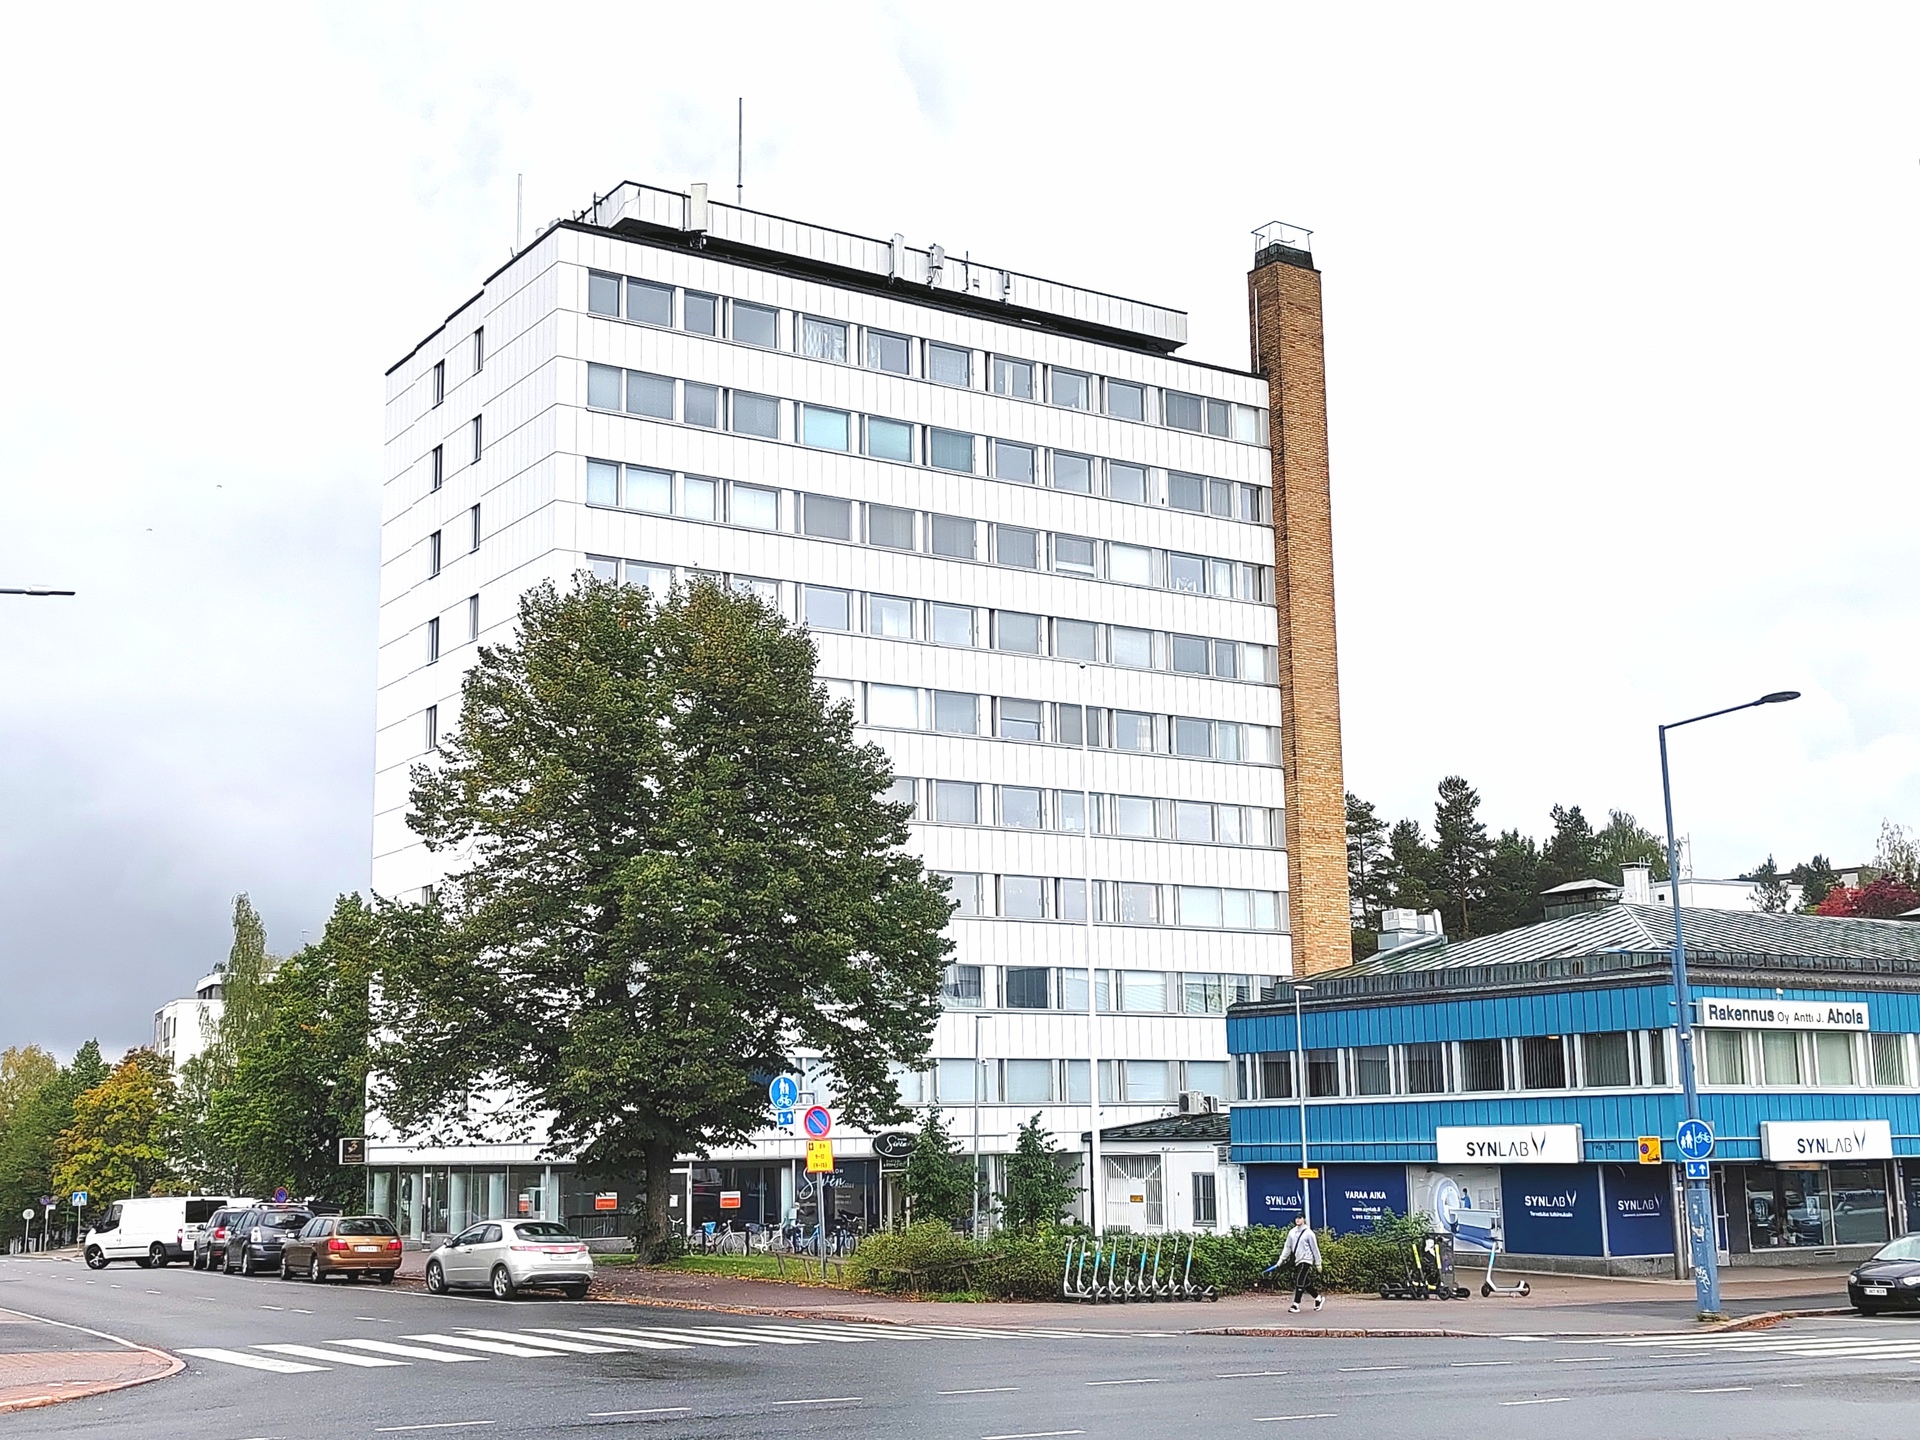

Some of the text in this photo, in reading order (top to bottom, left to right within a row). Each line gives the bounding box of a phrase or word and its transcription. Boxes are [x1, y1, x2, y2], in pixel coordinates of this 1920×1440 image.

[1708, 1004, 1864, 1025] Rakennus Oy Antti J. Ahola
[1466, 1141, 1529, 1157] SYNLAB
[1797, 1137, 1853, 1154] SYNLAB
[1265, 1195, 1298, 1206] SYNLAB
[1344, 1190, 1387, 1200] VARAA AIKA
[1524, 1195, 1566, 1208] SYNLAB
[1617, 1200, 1655, 1211] SYNLAB
